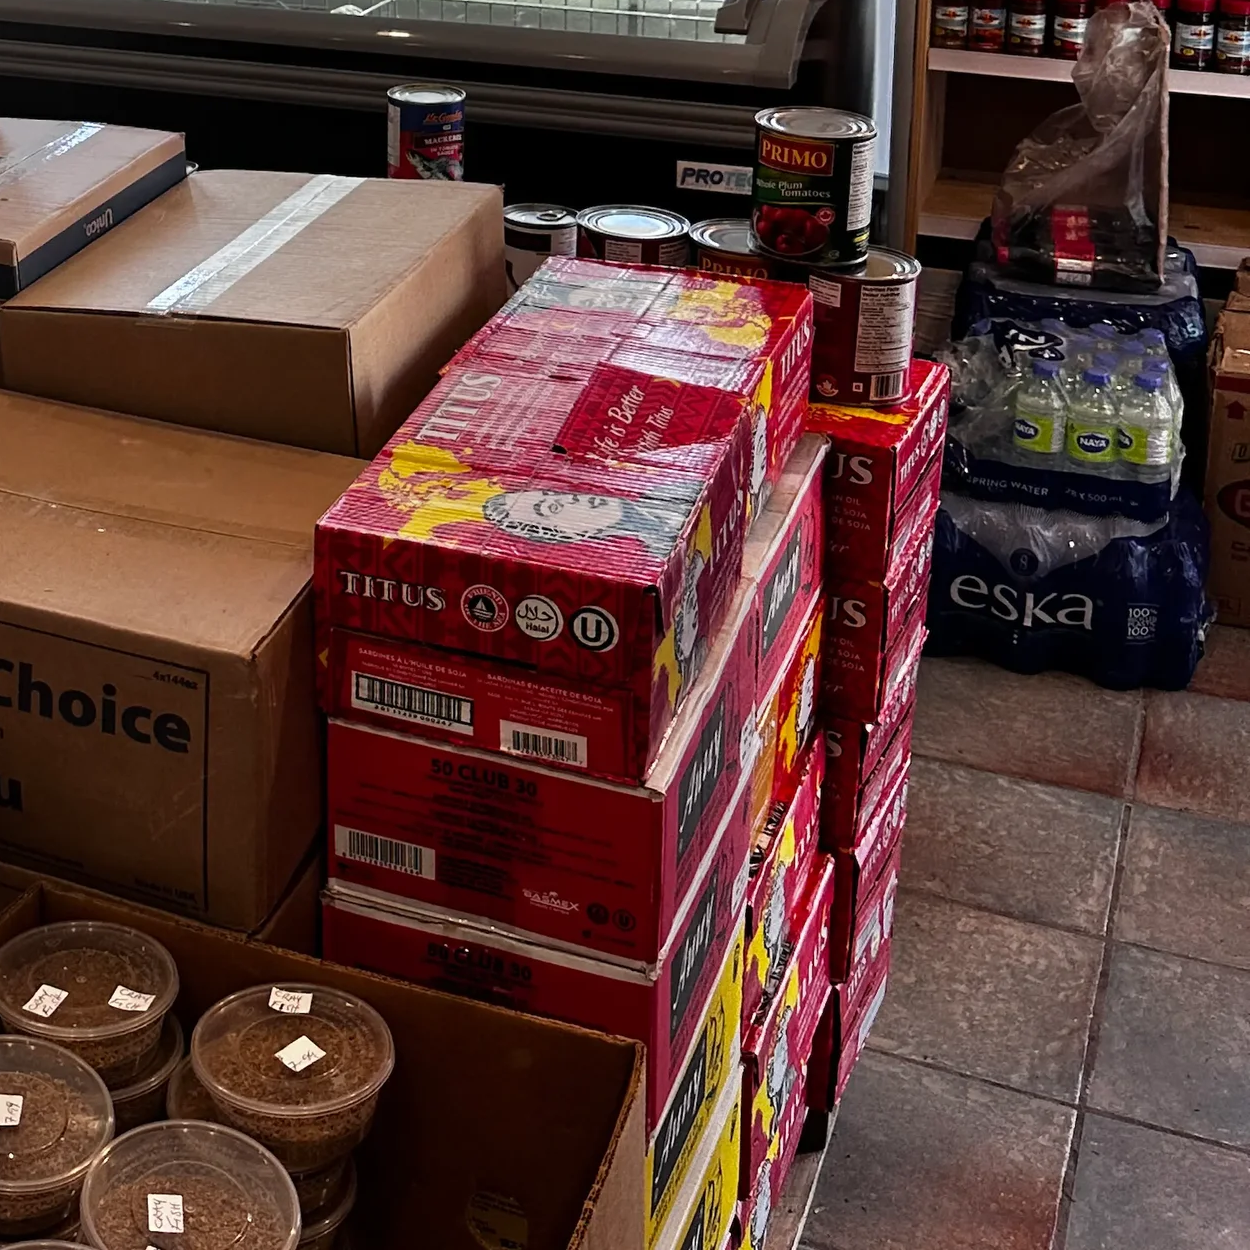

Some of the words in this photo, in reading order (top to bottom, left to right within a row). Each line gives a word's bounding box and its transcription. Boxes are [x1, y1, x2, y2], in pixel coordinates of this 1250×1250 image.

[762, 139, 827, 169] PRIMO
[777, 180, 803, 191] Plum
[781, 188, 831, 199] Tomatoes
[85, 208, 114, 238] Unico
[780, 320, 811, 381] TITUS
[415, 372, 502, 443] TITUS
[606, 384, 646, 426] Better
[645, 404, 675, 431] Titus
[1079, 436, 1107, 449] NAYA
[1010, 481, 1049, 497] WATER
[846, 519, 871, 531] SOJA
[340, 570, 446, 612] TITUS
[950, 574, 1094, 630] eska
[525, 620, 550, 634] Halal
[580, 616, 602, 639] U
[358, 647, 395, 665] SARDINES
[435, 665, 446, 675] DE
[446, 667, 467, 679] SOJA
[486, 673, 526, 690] SARDINAS
[526, 681, 539, 691] EN
[430, 758, 454, 777] 50
[457, 764, 510, 791] CLUB
[515, 777, 538, 797] 30
[453, 945, 505, 974] CLUB
[509, 961, 533, 981] 30
